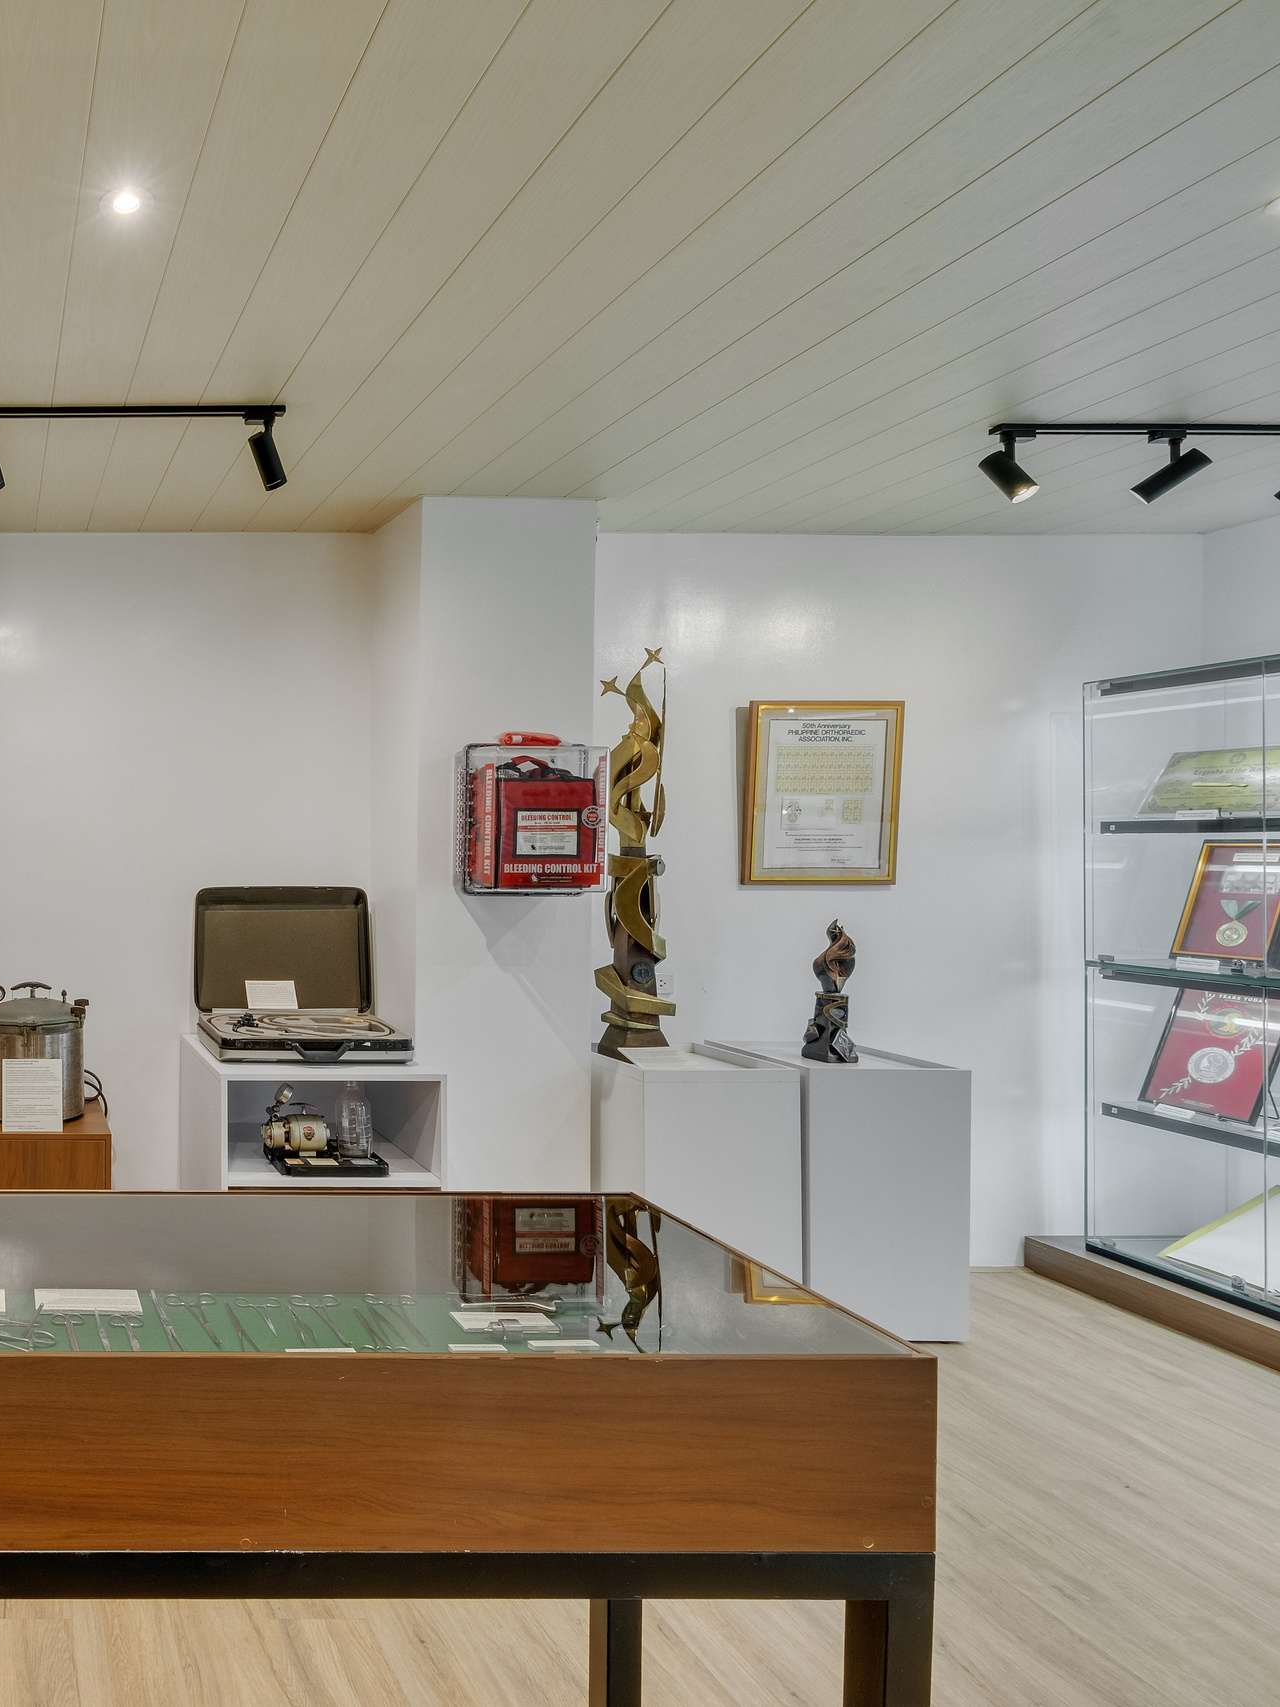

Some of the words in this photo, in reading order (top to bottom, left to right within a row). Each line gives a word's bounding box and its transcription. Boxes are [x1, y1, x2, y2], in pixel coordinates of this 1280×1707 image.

[485, 769, 493, 813] BLEEDING
[483, 859, 491, 875] KIT
[504, 863, 543, 873] BLEEDING
[544, 863, 582, 873] CONTROL
[583, 863, 598, 873] KIT
